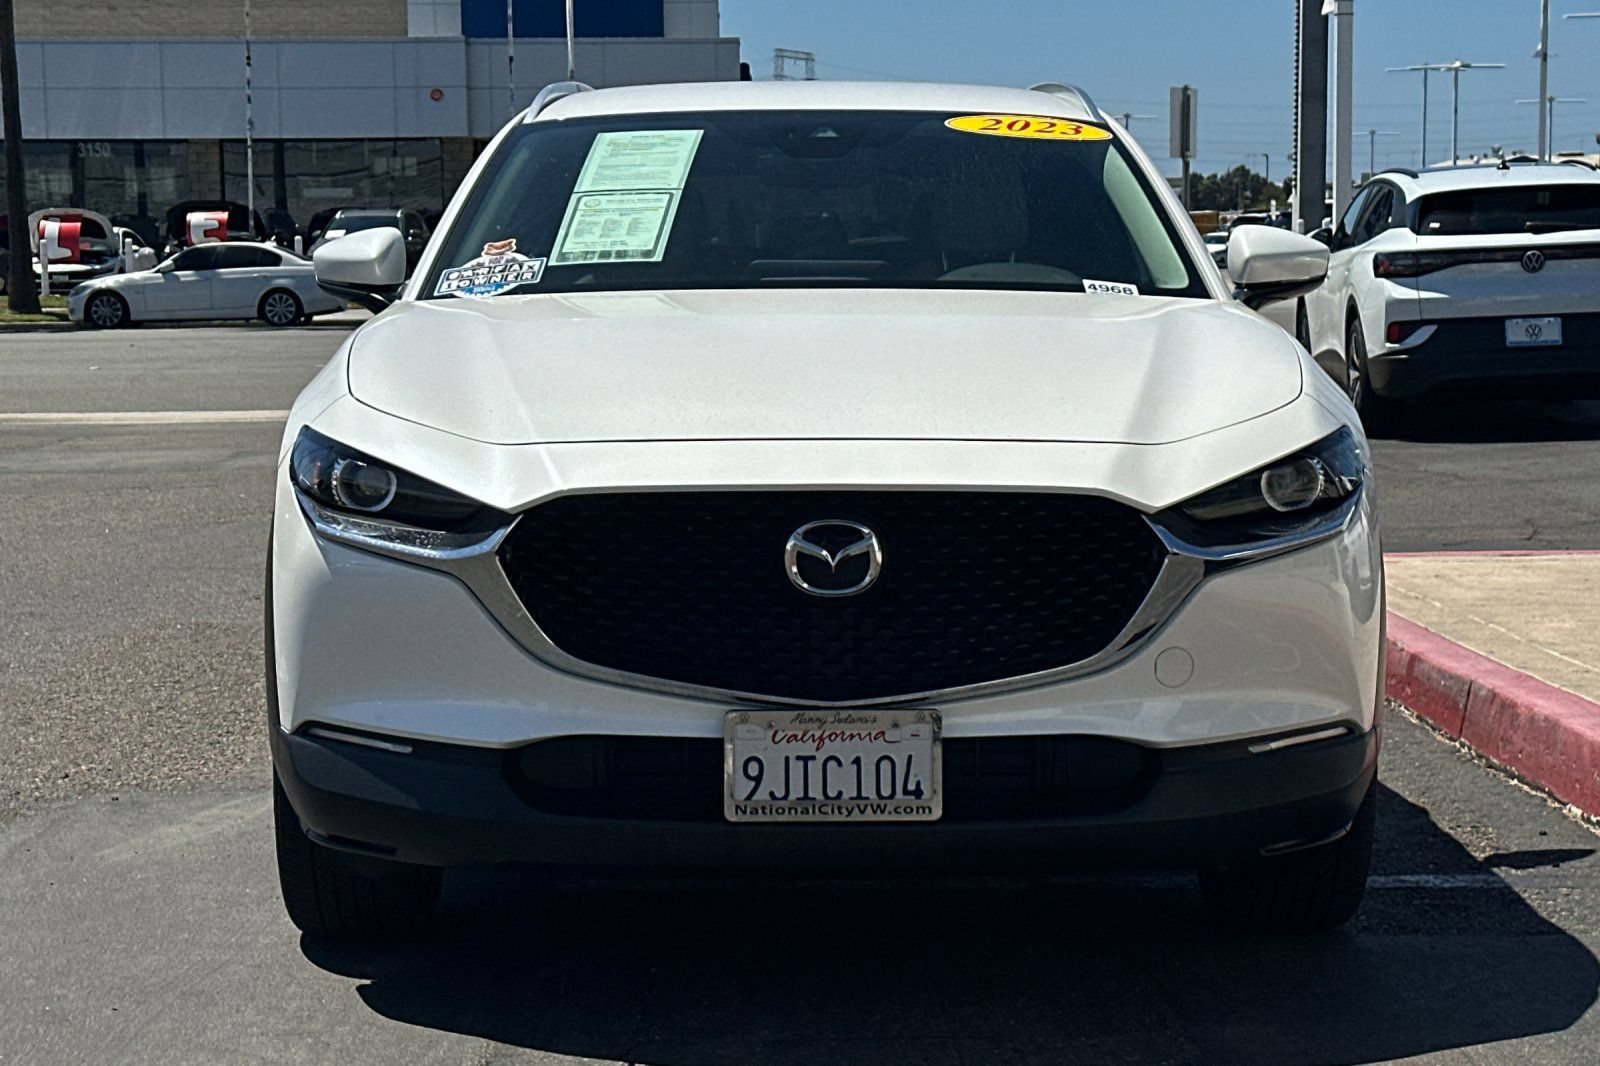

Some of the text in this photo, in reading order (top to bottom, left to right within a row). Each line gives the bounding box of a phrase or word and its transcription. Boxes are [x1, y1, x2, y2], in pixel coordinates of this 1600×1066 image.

[978, 118, 1083, 135] 2023
[78, 142, 111, 157] 3150
[771, 729, 901, 751] California
[742, 753, 924, 801] 9JIC104
[735, 803, 932, 817] NationalCityVW.com
